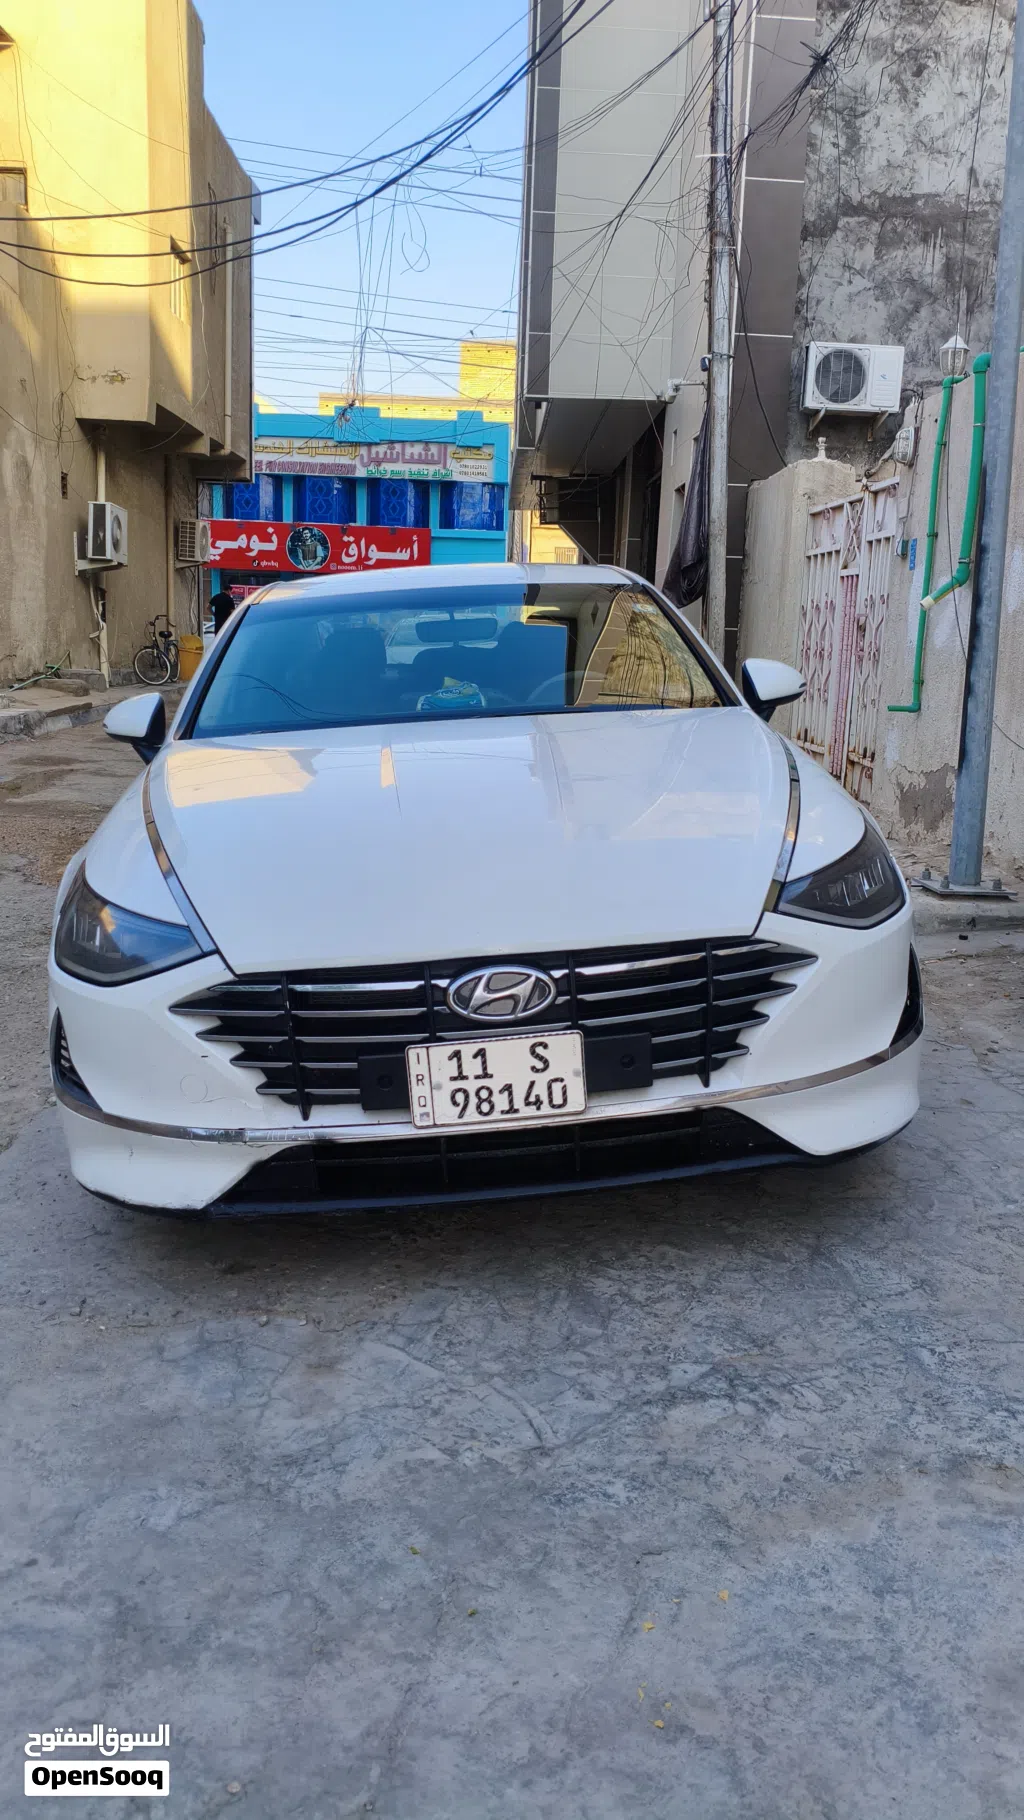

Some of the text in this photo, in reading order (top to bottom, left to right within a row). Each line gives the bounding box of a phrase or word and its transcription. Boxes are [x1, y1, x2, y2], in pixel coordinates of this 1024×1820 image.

[209, 526, 418, 565] أسواق نومي
[447, 1047, 493, 1082] 11
[528, 1040, 550, 1073] S
[450, 1076, 568, 1119] 98140
